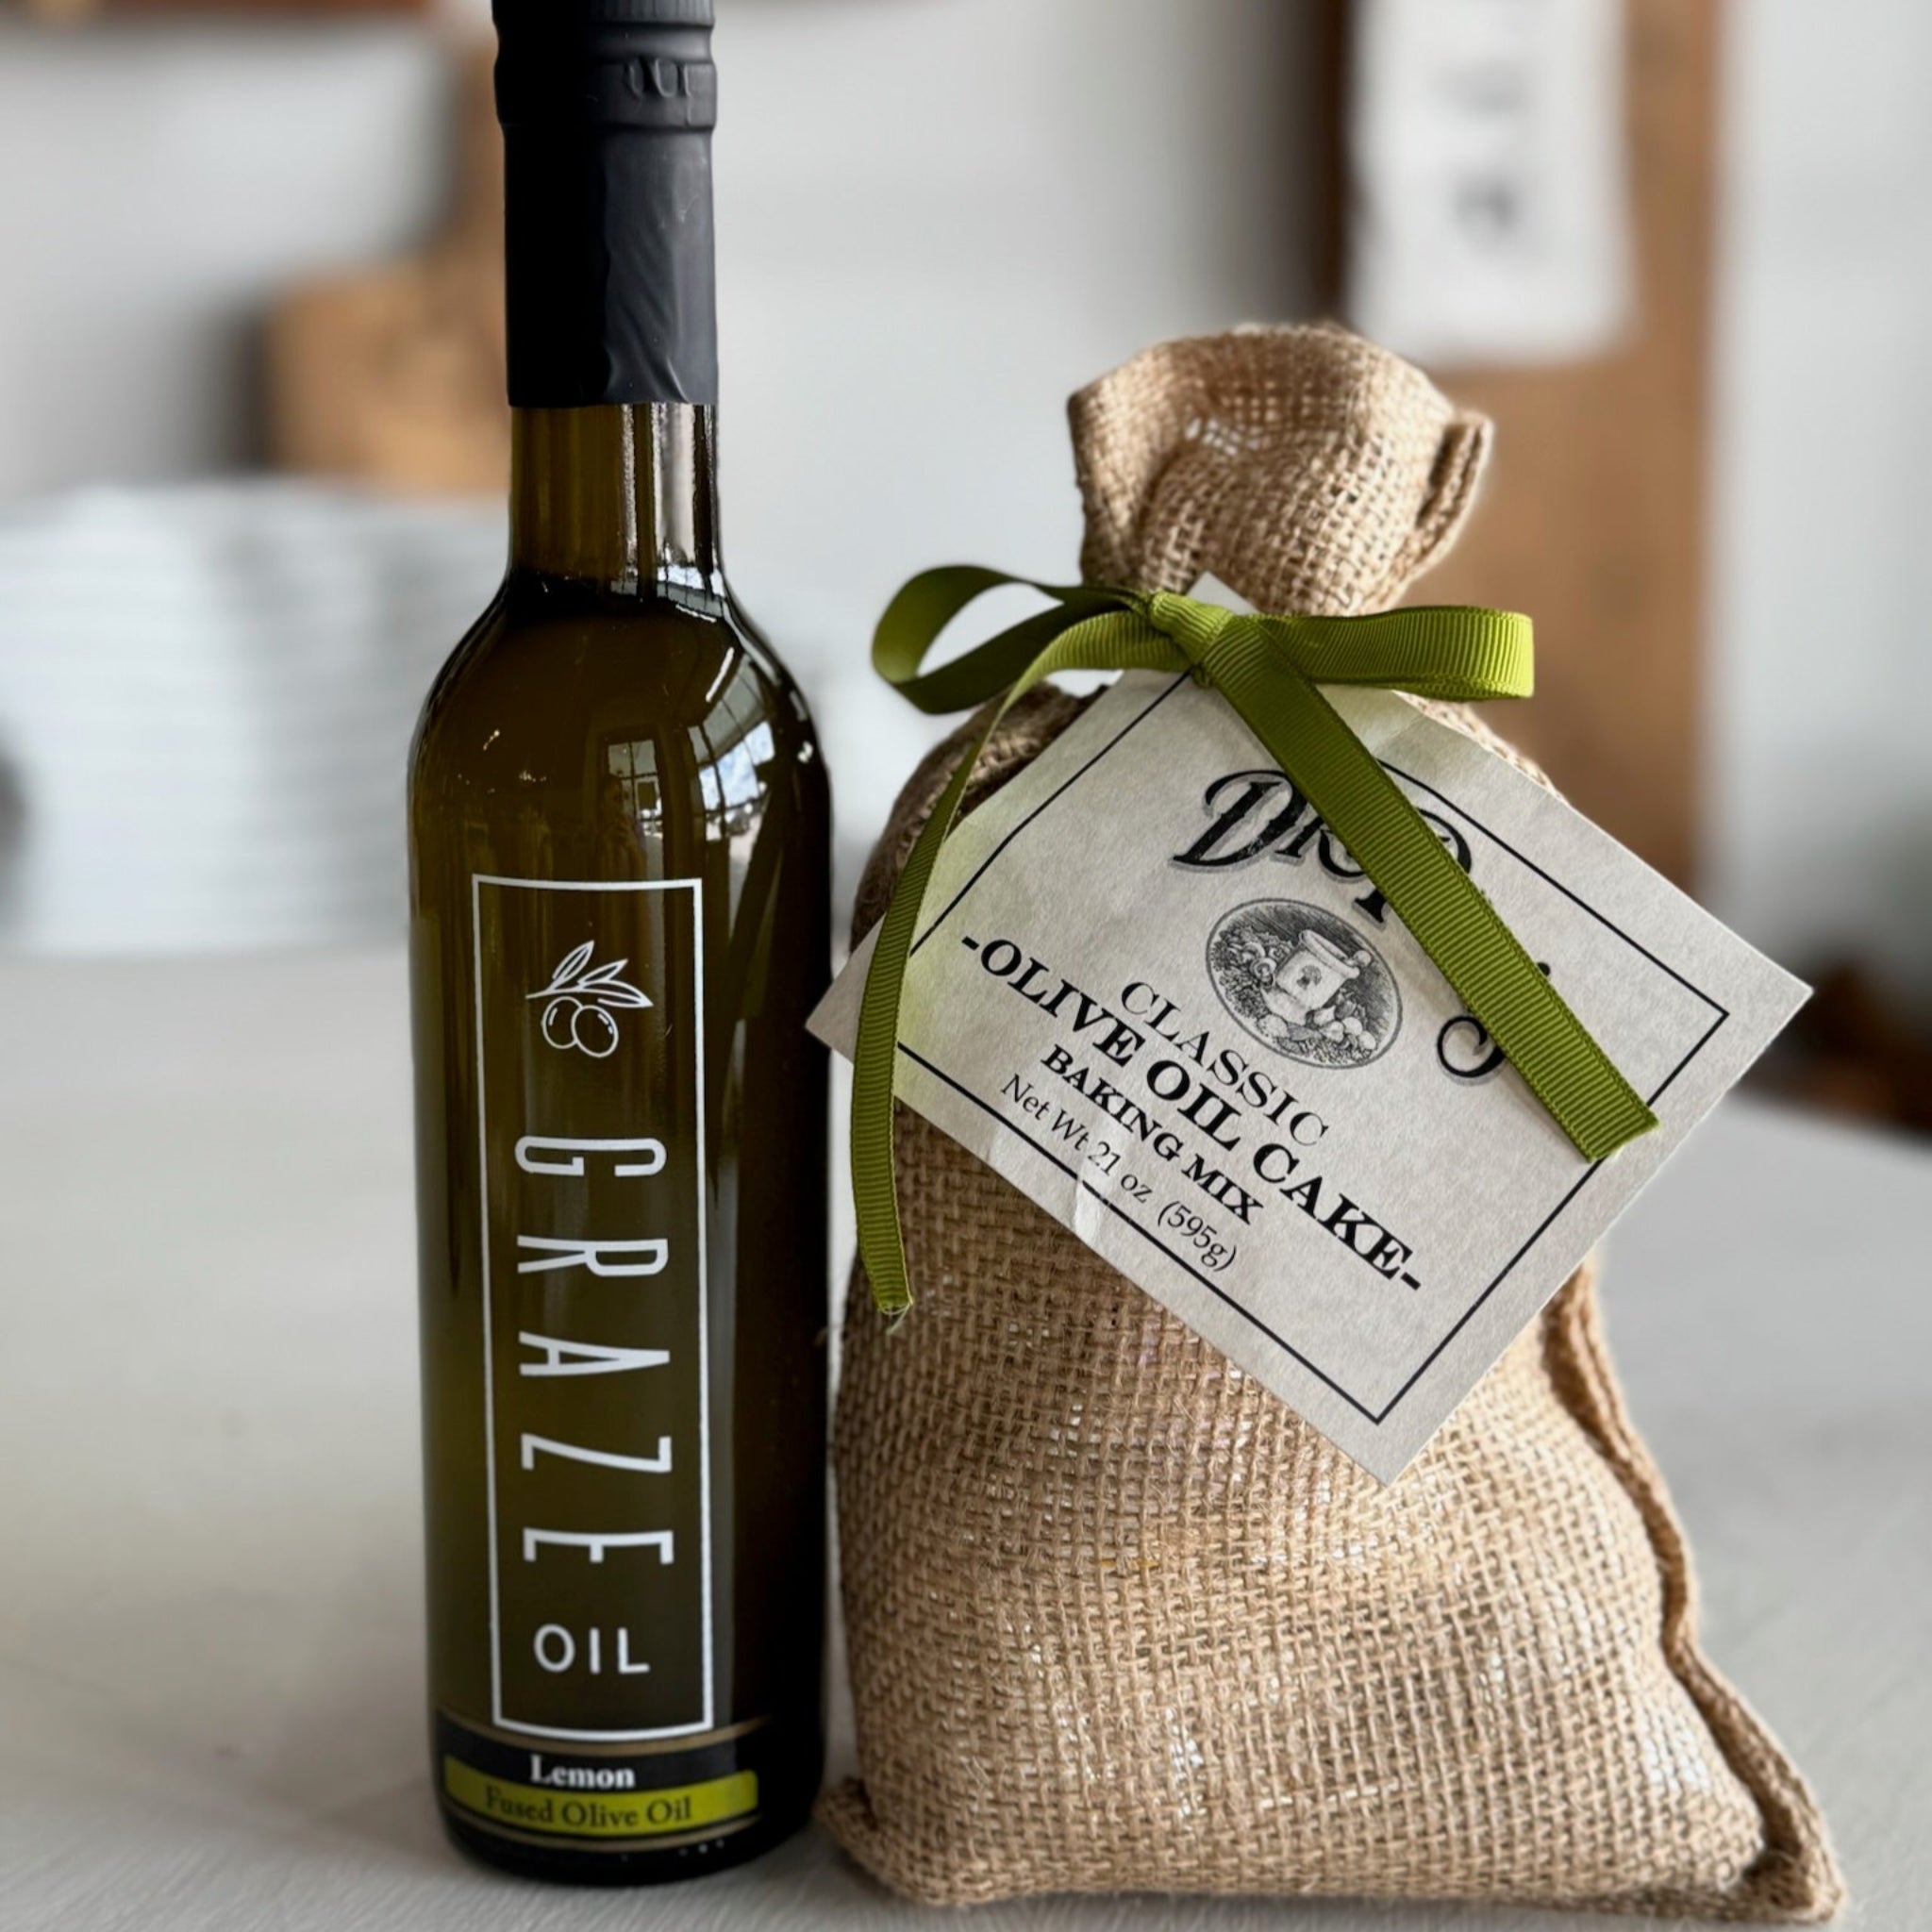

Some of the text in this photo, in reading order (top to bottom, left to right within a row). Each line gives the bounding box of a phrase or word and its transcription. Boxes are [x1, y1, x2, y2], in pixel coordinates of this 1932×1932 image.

[1121, 981, 1329, 1146] CLASSIC
[1146, 1059, 1241, 1151] OIL
[1001, 1074, 1238, 1272] Net Wt 21 oz (595g)
[1041, 1044, 1264, 1224] BAKING MIX
[514, 1135, 674, 1564] GRAZE
[534, 1624, 650, 1674] OIL
[485, 1785, 691, 1828] Fused Olive Oil
[530, 1754, 636, 1789] Lemon
